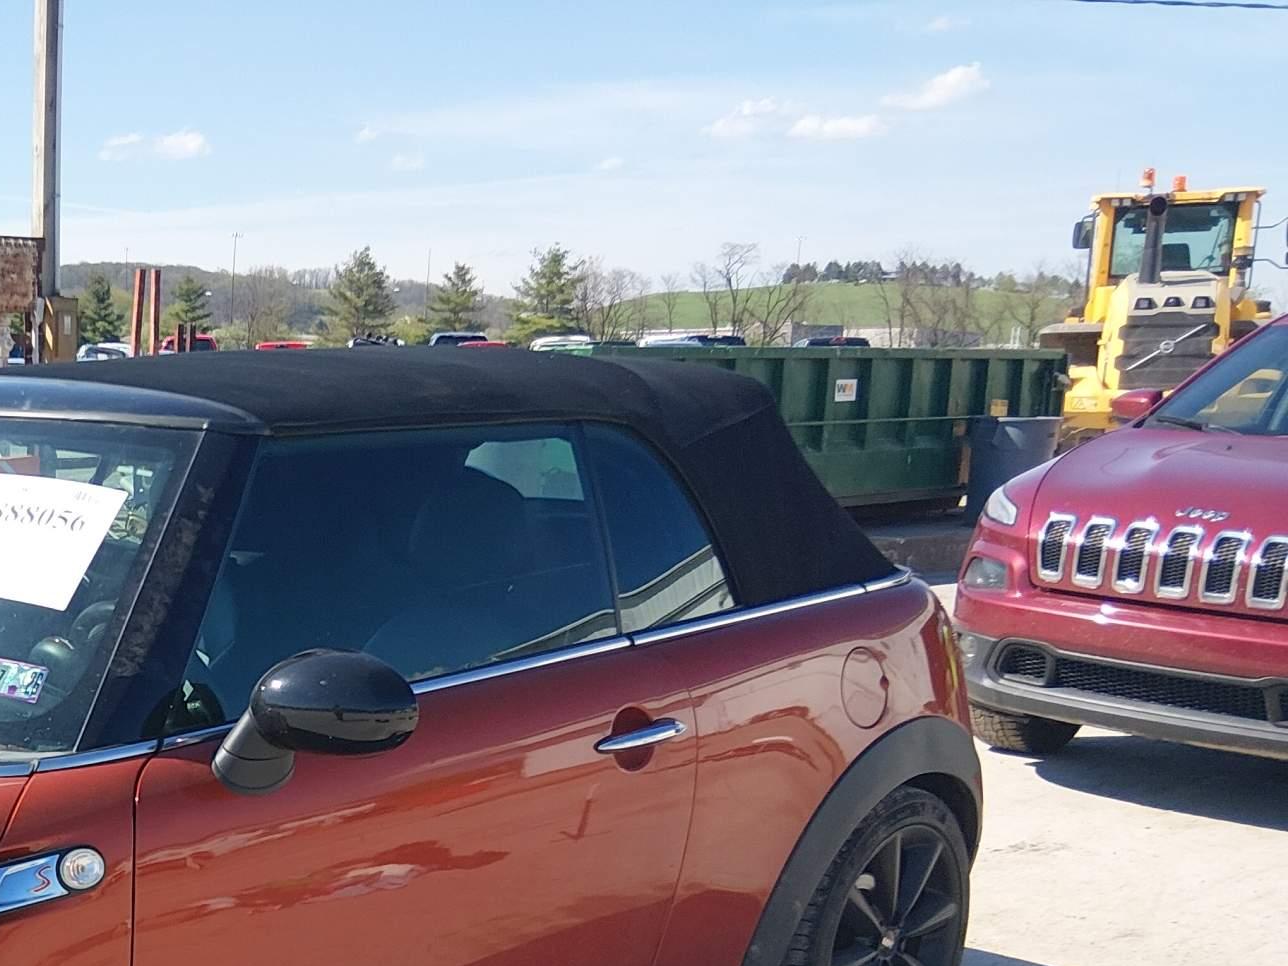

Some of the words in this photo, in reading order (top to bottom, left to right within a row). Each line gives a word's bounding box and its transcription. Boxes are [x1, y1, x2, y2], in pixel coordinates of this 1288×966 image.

[837, 384, 853, 393] WM
[1175, 506, 1231, 522] Jeep
[31, 865, 52, 892] S
